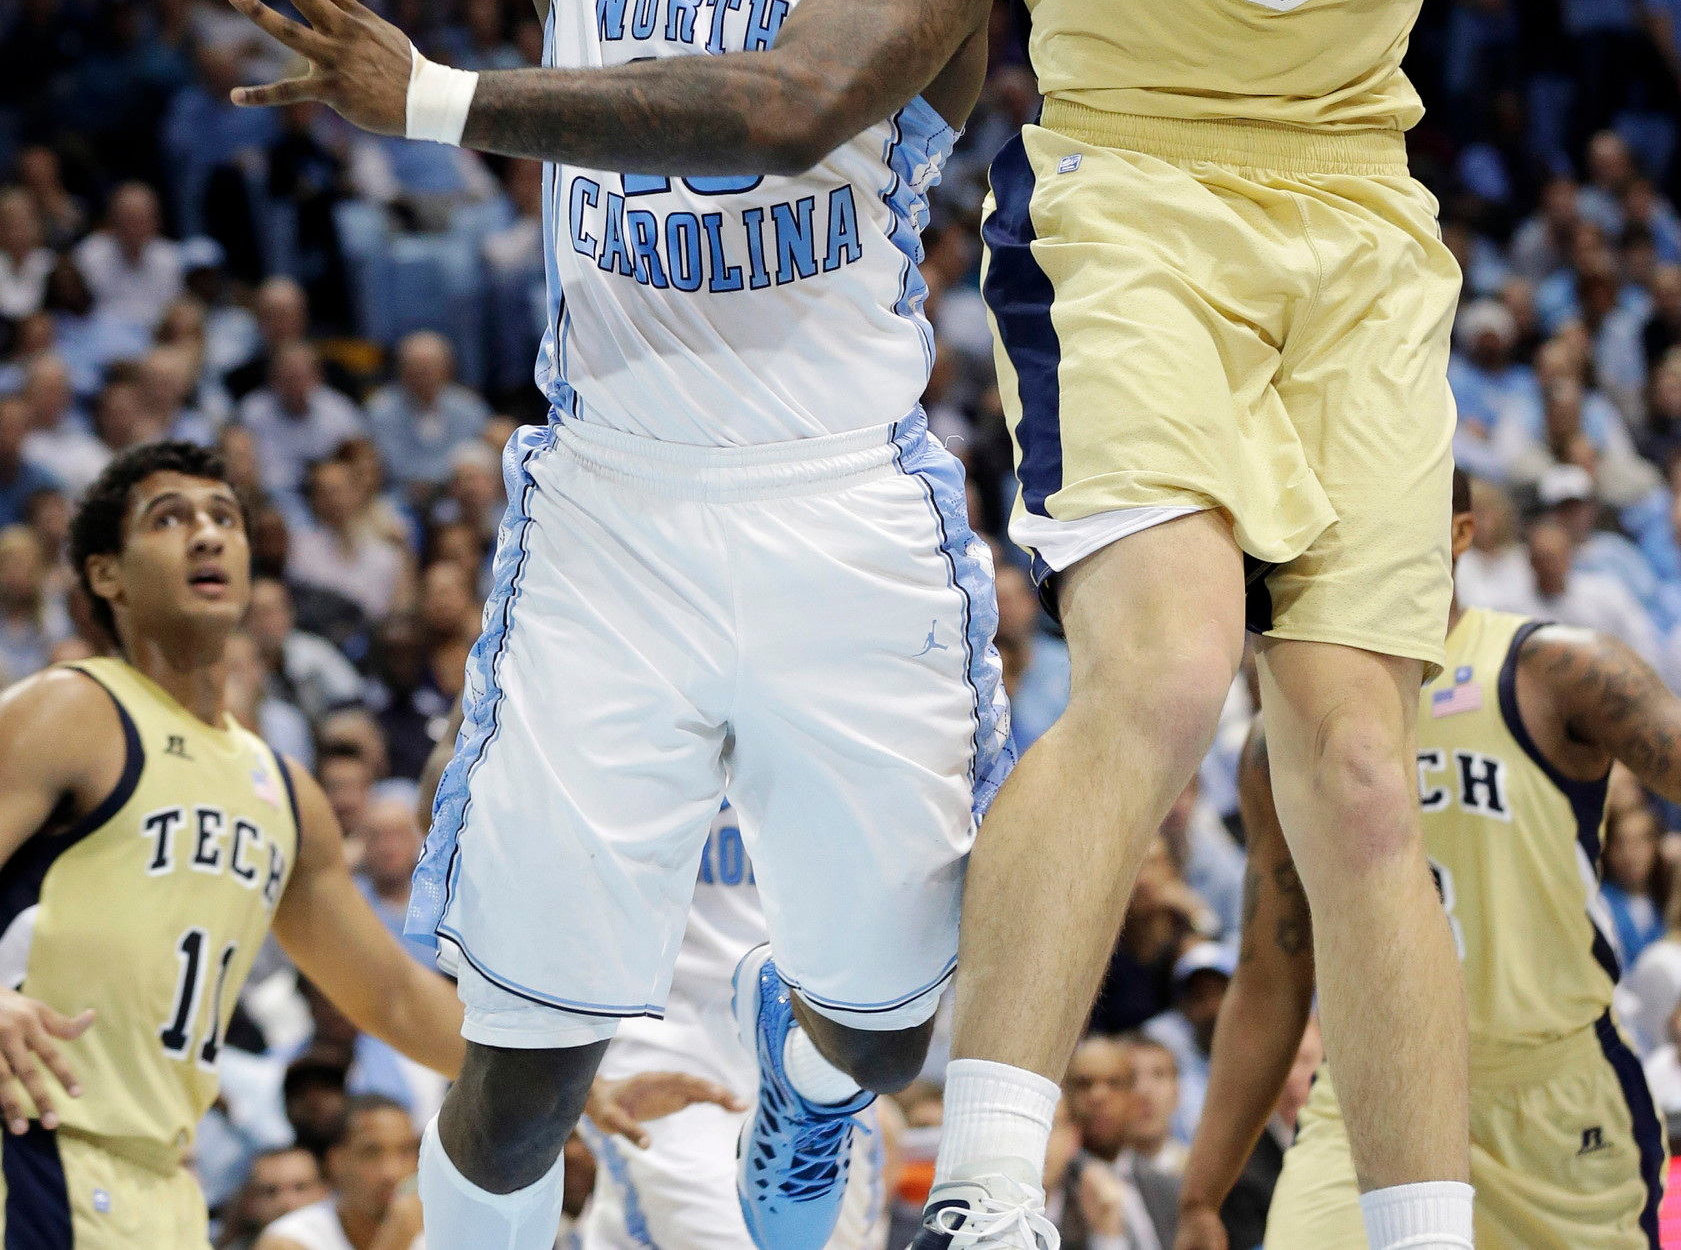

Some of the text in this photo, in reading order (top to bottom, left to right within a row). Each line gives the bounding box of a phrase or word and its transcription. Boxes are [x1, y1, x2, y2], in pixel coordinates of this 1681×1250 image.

[569, 176, 863, 293] CAROLINA
[141, 805, 286, 909] TECH
[159, 926, 239, 1073] 11
